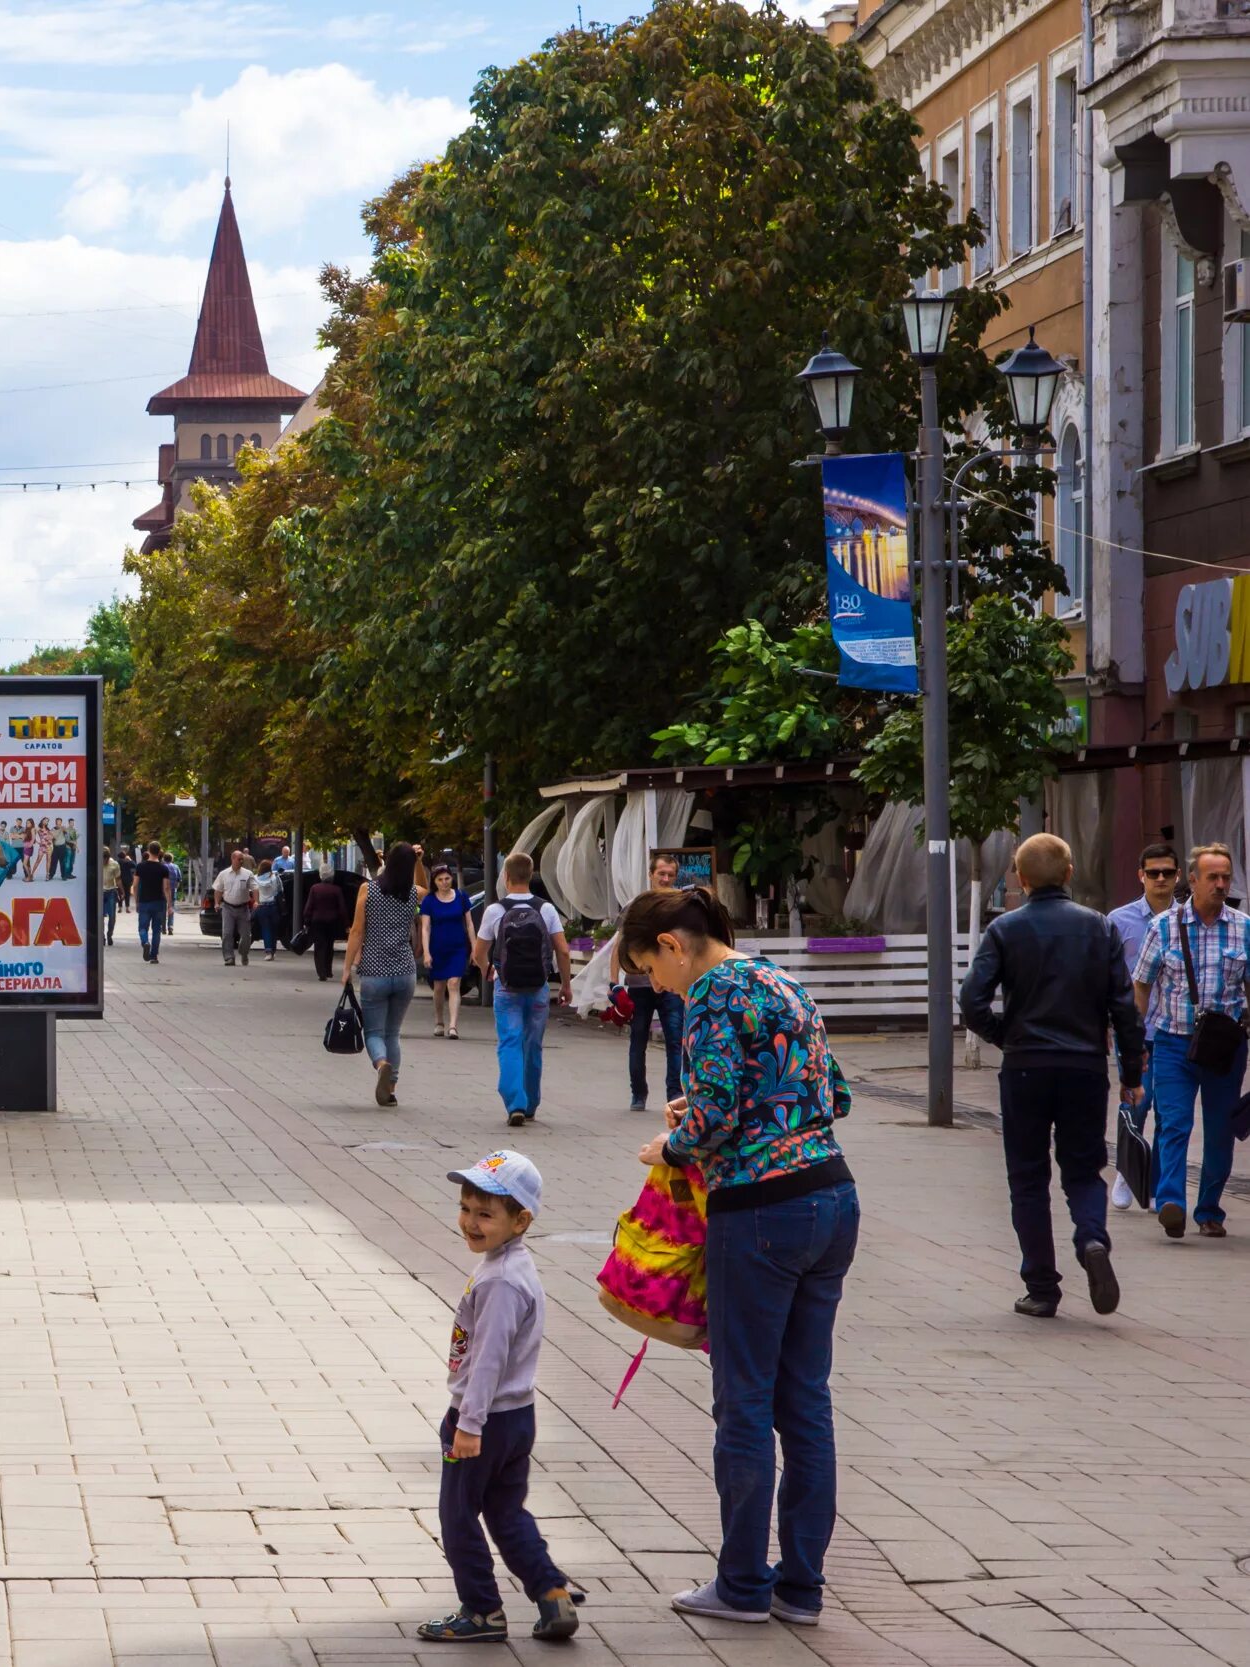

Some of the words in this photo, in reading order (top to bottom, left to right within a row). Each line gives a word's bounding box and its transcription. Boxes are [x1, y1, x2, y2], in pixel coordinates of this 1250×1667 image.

[841, 594, 861, 609] 80
[8, 715, 79, 740] ТНТ
[24, 742, 63, 750] САРАТОВ
